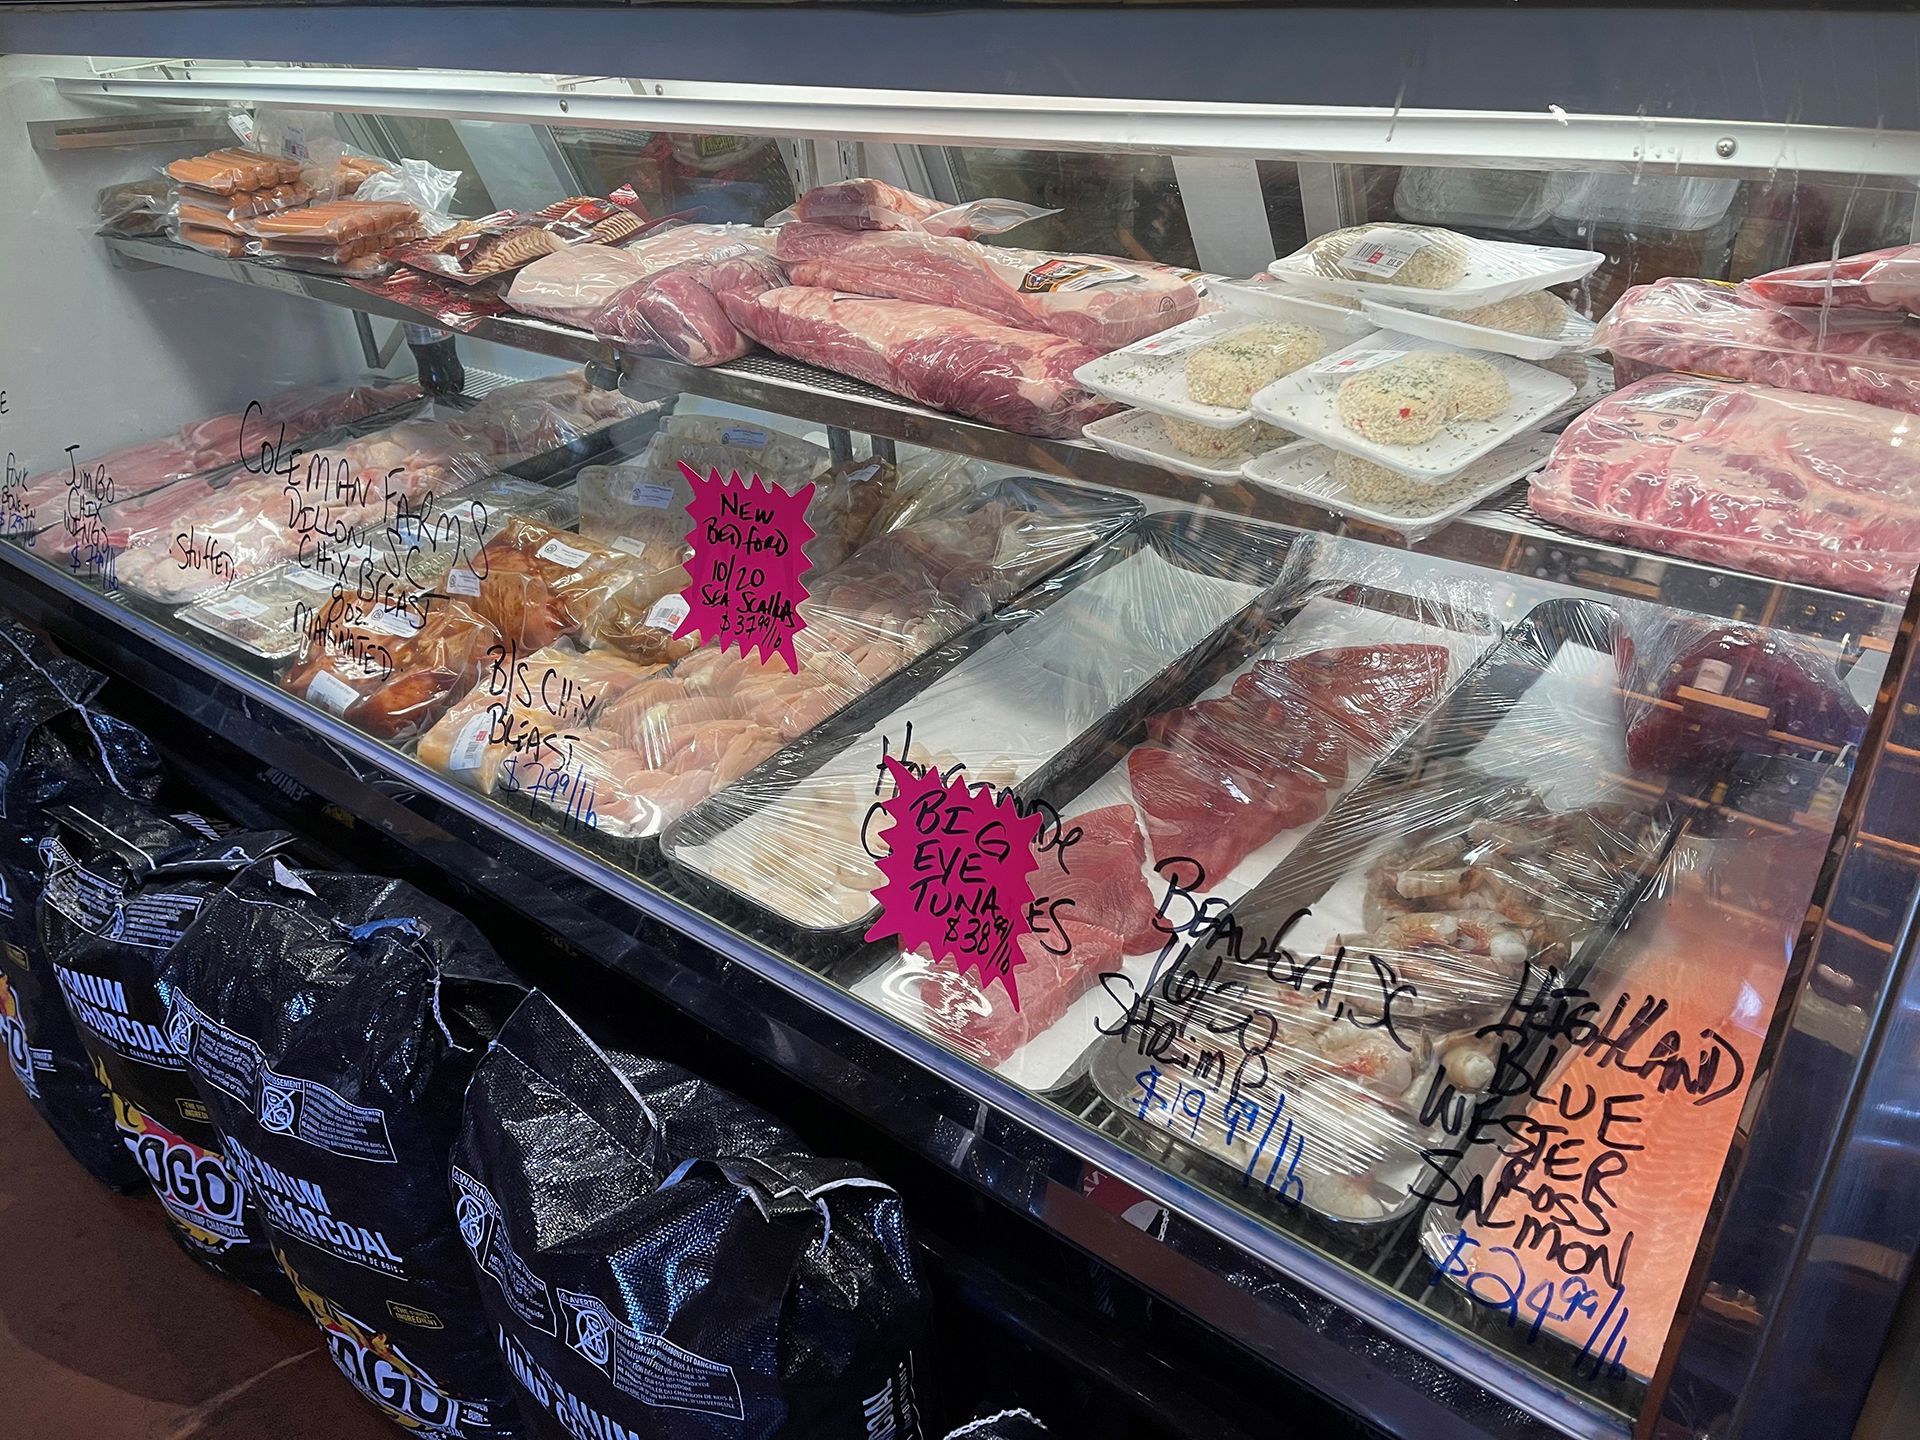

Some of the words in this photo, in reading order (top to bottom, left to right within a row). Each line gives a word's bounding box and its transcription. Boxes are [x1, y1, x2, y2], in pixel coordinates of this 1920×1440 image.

[383, 467, 488, 580] FARMS
[720, 492, 775, 524] NEW
[701, 583, 730, 608] SEA
[712, 554, 765, 592] 10/20
[908, 789, 1011, 864] BIG
[908, 873, 1000, 918] TUNA
[913, 838, 987, 886] EYE
[70, 992, 179, 1056] CHARCOA
[1510, 960, 1745, 1106] HIGHLAND
[1475, 1022, 1645, 1151] BLUE
[1419, 1064, 1628, 1208] WESTER
[458, 1174, 495, 1213] WARNING
[1407, 1148, 1634, 1290] SALMON
[1499, 1156, 1612, 1237] ROSS
